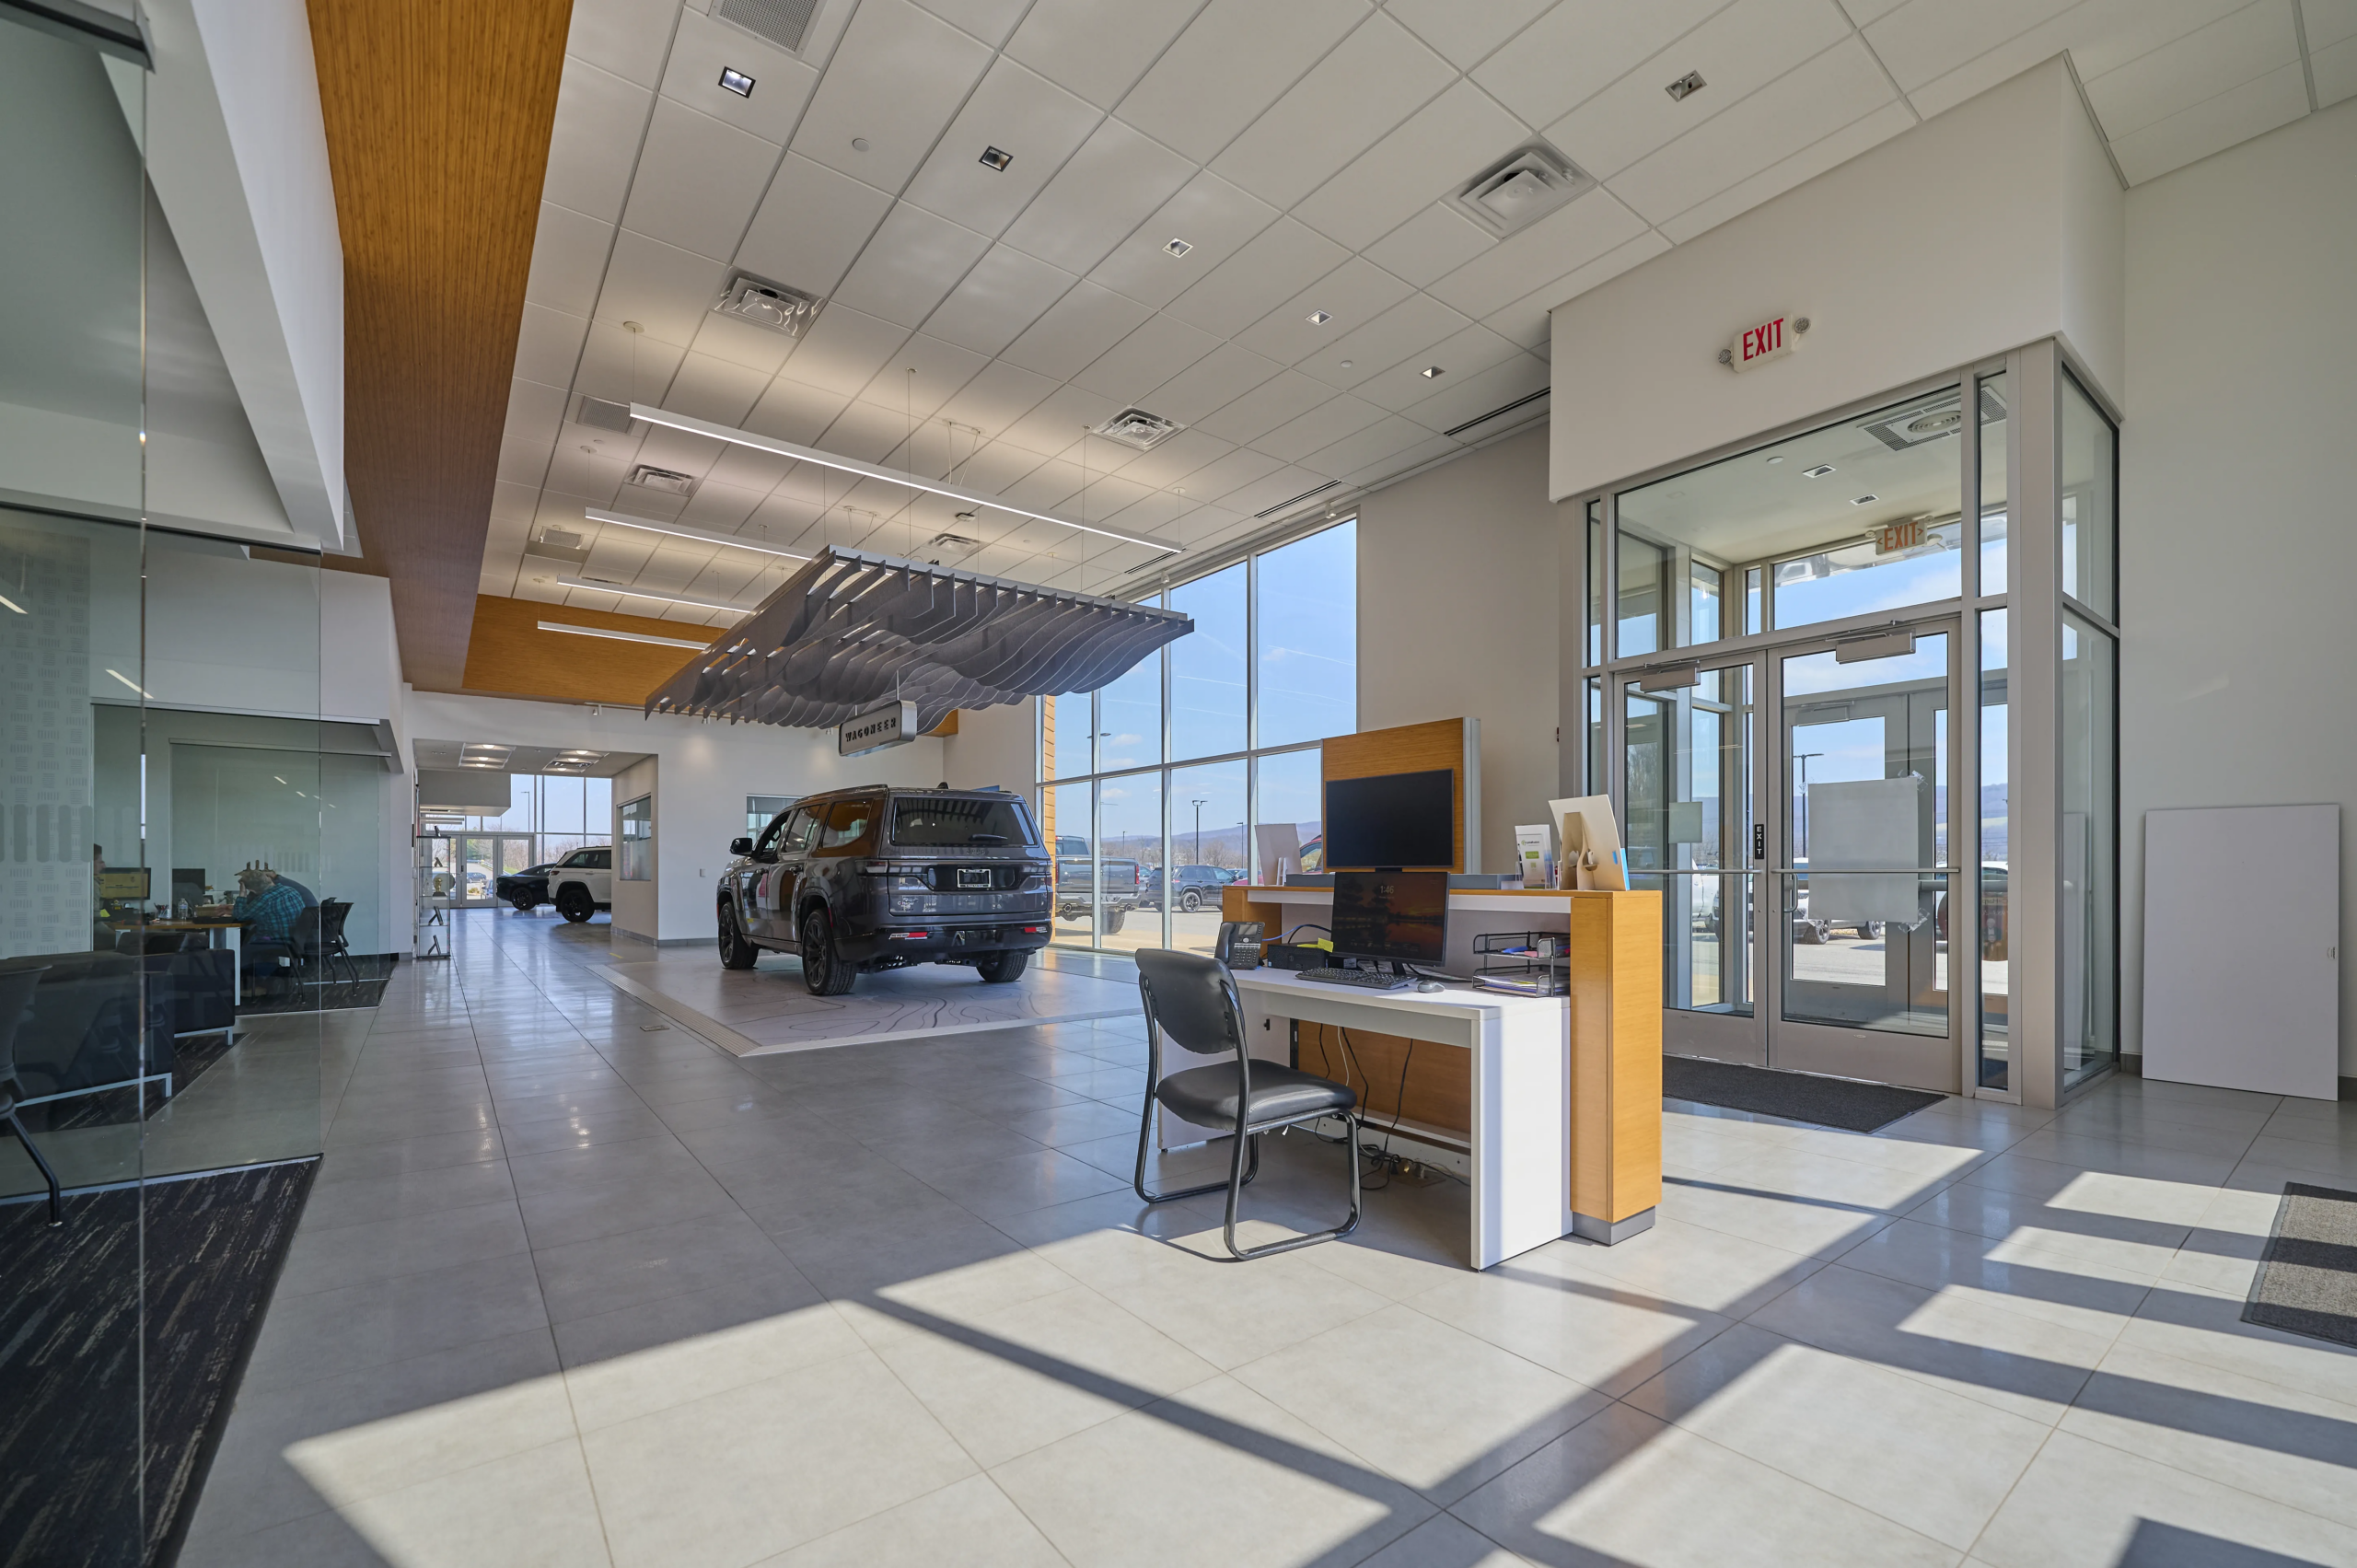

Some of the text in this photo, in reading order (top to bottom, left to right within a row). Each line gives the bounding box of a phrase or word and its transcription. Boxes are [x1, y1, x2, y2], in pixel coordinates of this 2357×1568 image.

[1743, 318, 1783, 361] EXIT
[1884, 521, 1918, 551] EXIT
[845, 717, 896, 742] WAGONEER
[1379, 885, 1395, 894] 1:46
